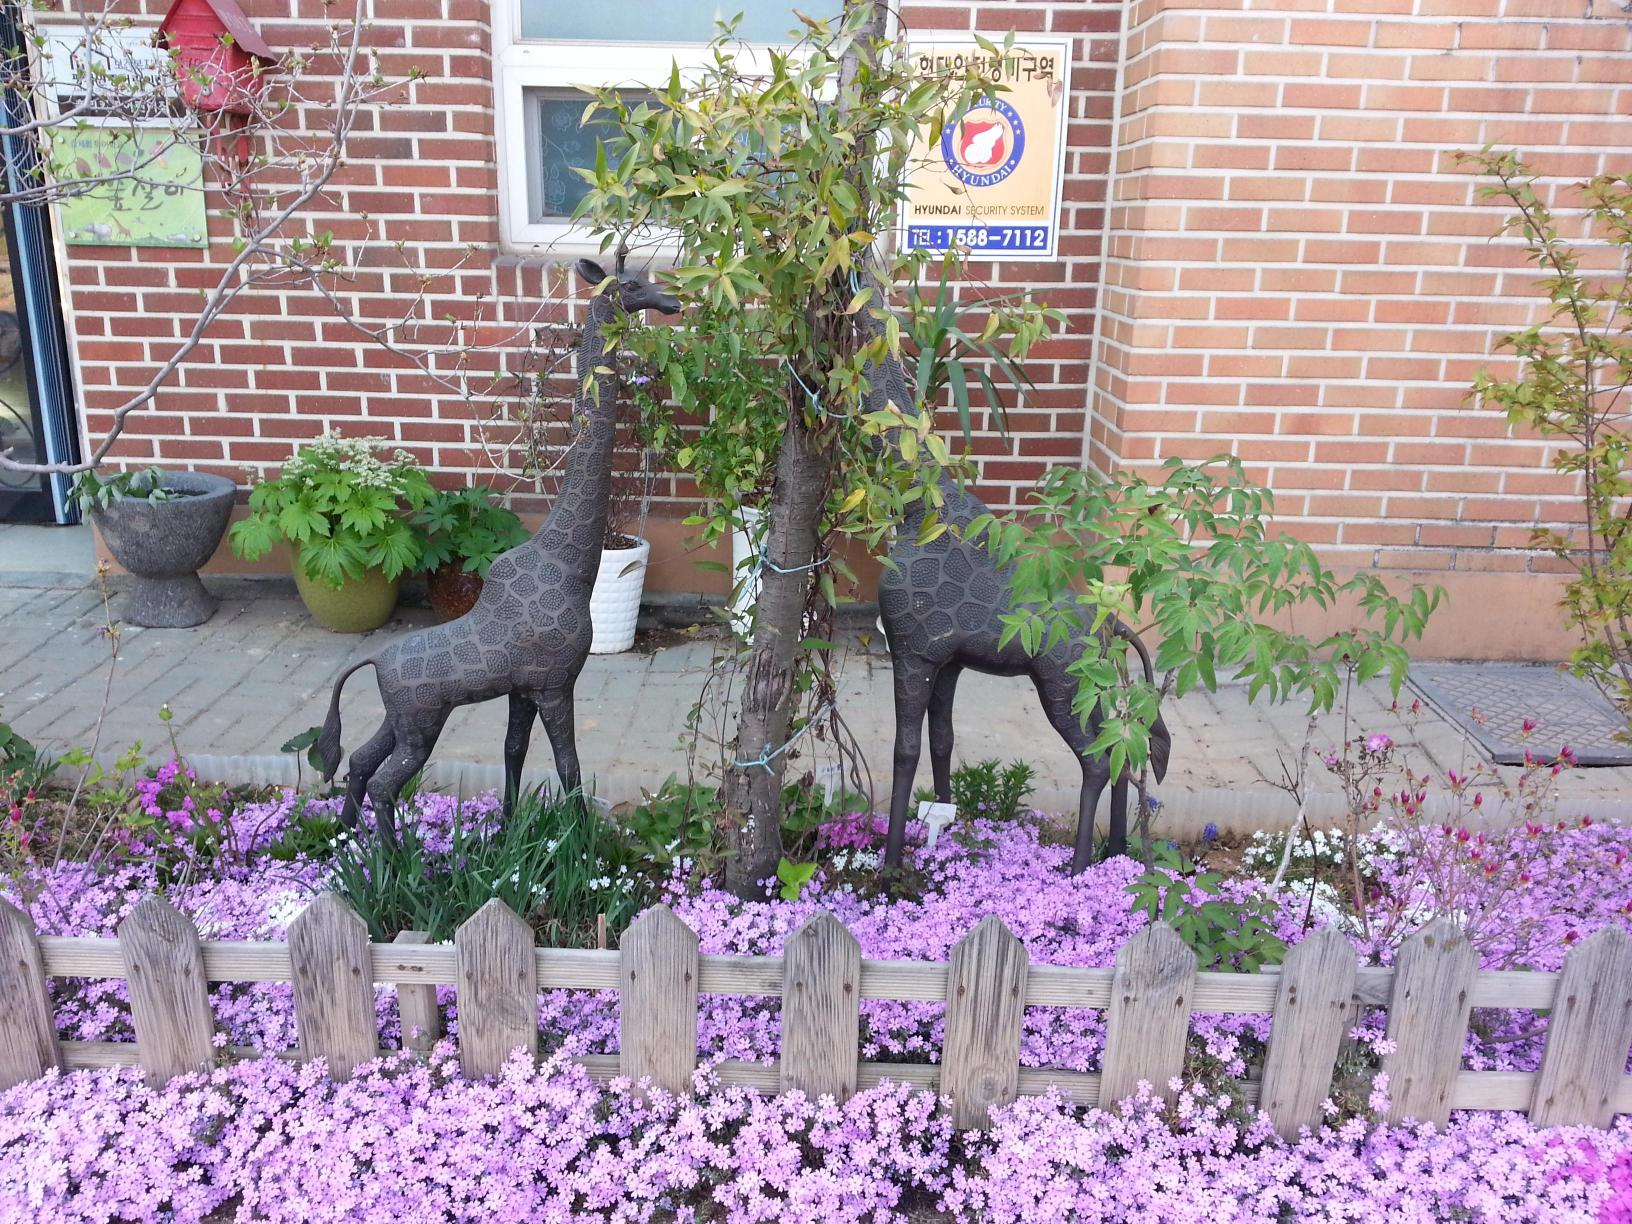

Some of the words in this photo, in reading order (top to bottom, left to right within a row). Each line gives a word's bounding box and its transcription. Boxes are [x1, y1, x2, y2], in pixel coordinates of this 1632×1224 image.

[951, 165, 1012, 186] HYUNDAI
[914, 205, 961, 215] HYUNDAI
[966, 205, 1007, 215] SECURITY
[1010, 205, 1045, 216] SYSTEM
[946, 228, 1045, 246] 1588-7112
